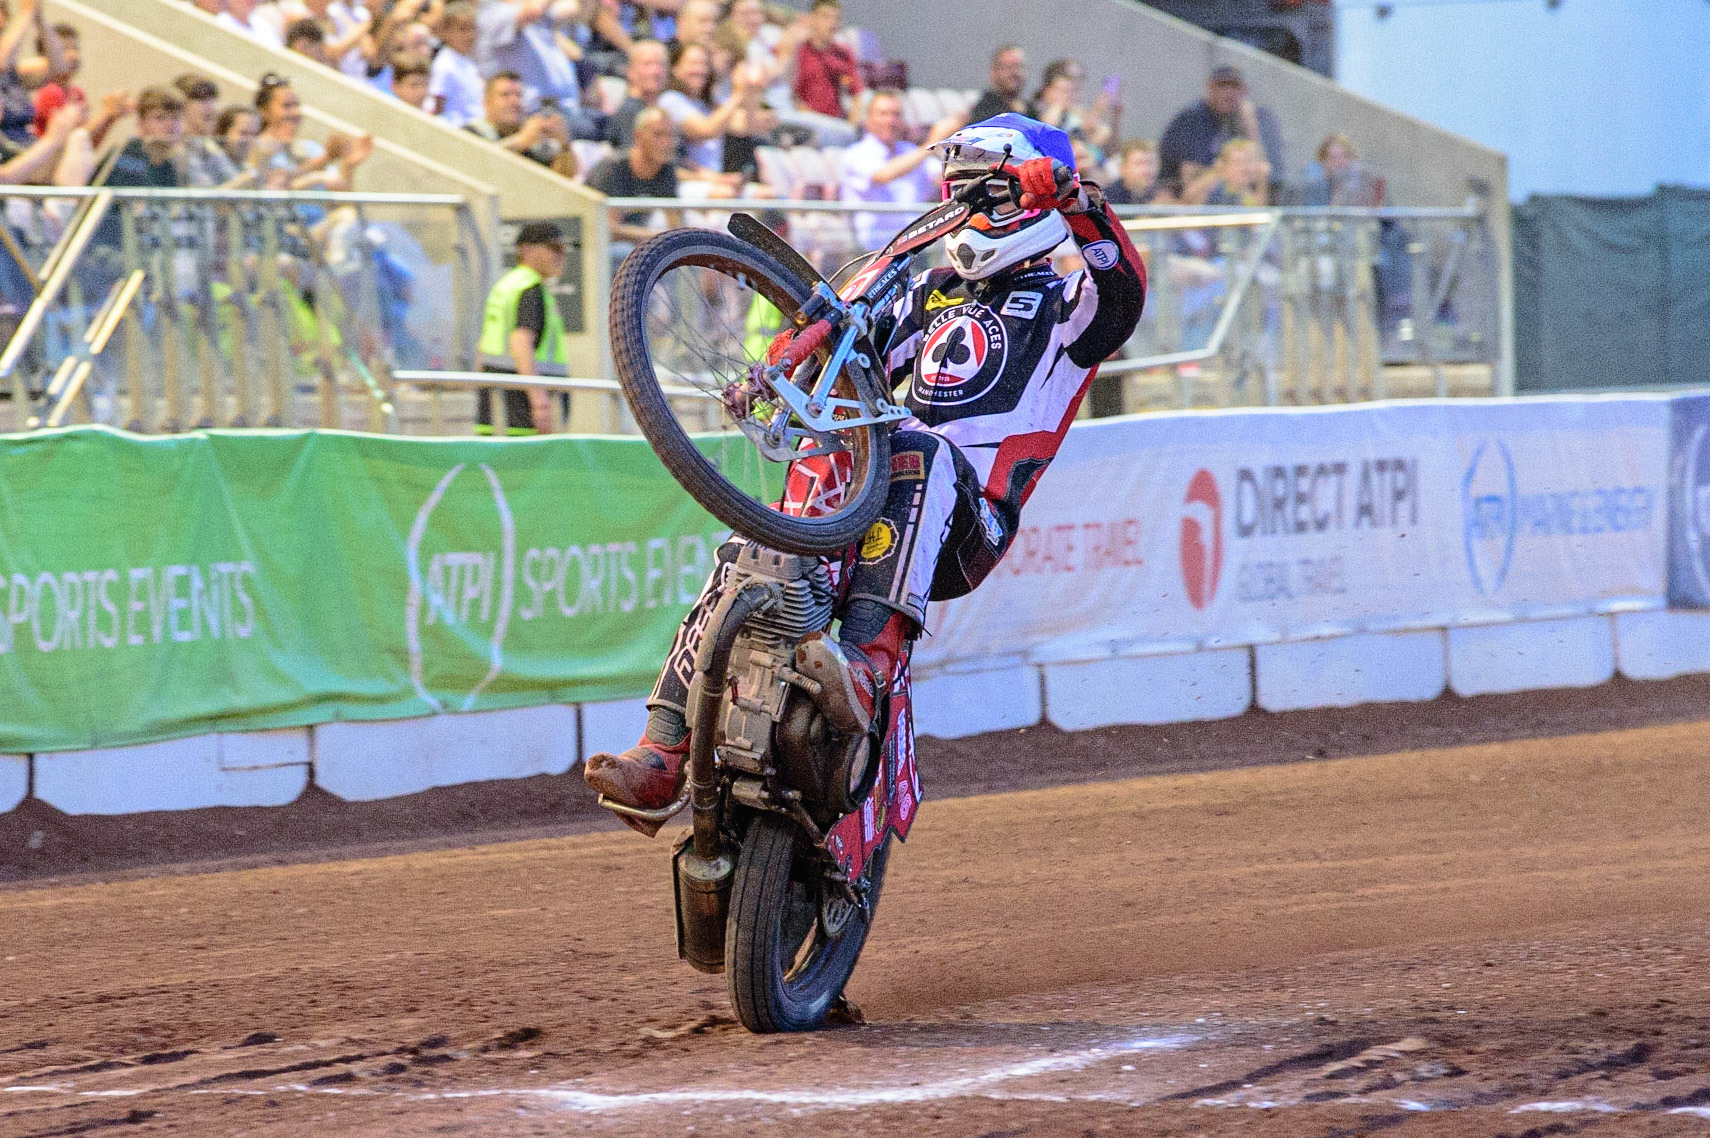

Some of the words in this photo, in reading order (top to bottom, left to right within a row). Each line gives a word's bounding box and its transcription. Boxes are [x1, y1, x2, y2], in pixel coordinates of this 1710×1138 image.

[907, 205, 966, 240] BETARD
[1091, 247, 1110, 265] ATPI
[1006, 296, 1037, 312] 5
[962, 305, 985, 319] VUE
[982, 318, 1003, 351] ACES
[1234, 460, 1348, 538] DIRECT
[1353, 456, 1420, 529] ATPI
[425, 551, 496, 626] ATPI
[519, 541, 638, 622] SPORTS
[0, 569, 120, 654] PORTS
[127, 560, 256, 647] EVENTS
